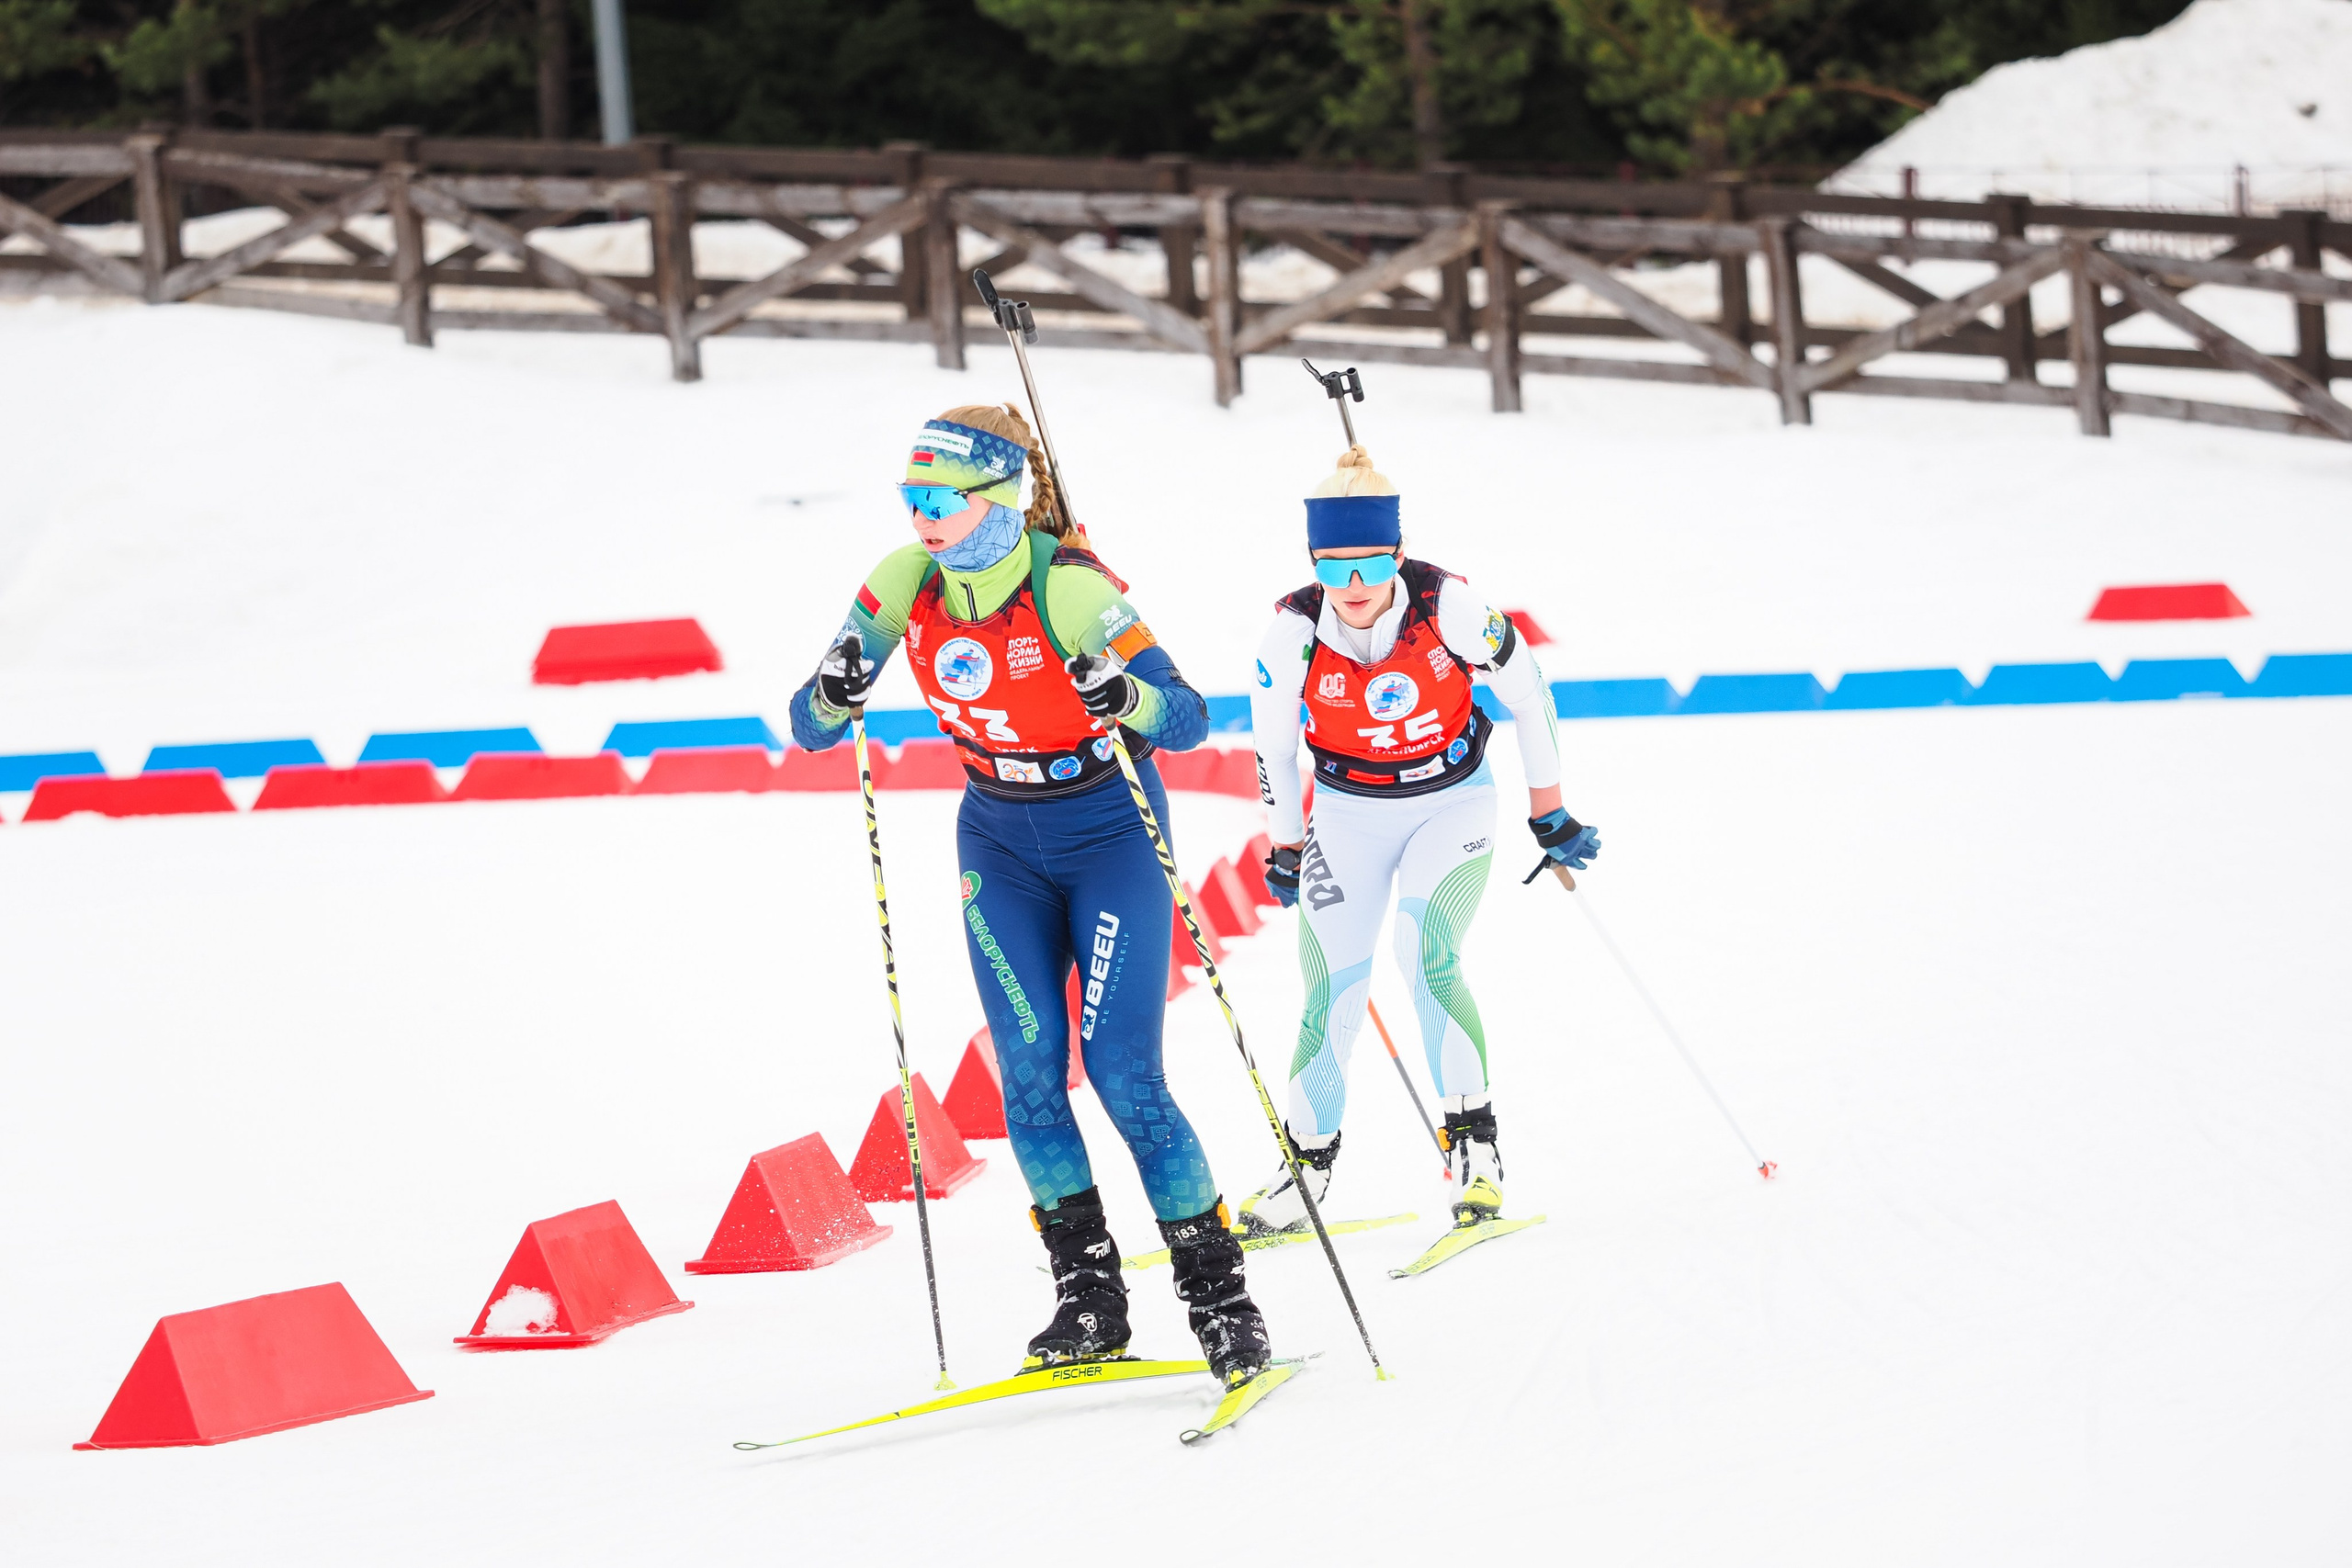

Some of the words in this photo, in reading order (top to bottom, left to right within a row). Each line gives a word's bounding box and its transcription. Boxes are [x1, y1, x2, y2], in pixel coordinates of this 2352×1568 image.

[1007, 637, 1033, 650] ПОРТ
[1007, 645, 1041, 661] НОРМА
[1008, 654, 1044, 671] ЖИЗНИ
[928, 694, 1020, 743] 33
[1357, 708, 1444, 750] 35
[1463, 837, 1487, 852] CRAFT
[1085, 910, 1120, 1007] BEEU
[967, 904, 1039, 1043] БЕЛОРУСНЕФТЬ
[1101, 1009, 1110, 1024] BE
[1108, 932, 1130, 1000] YOURSELF
[1175, 1225, 1198, 1240] 183
[1052, 1366, 1102, 1382] FISCHER
